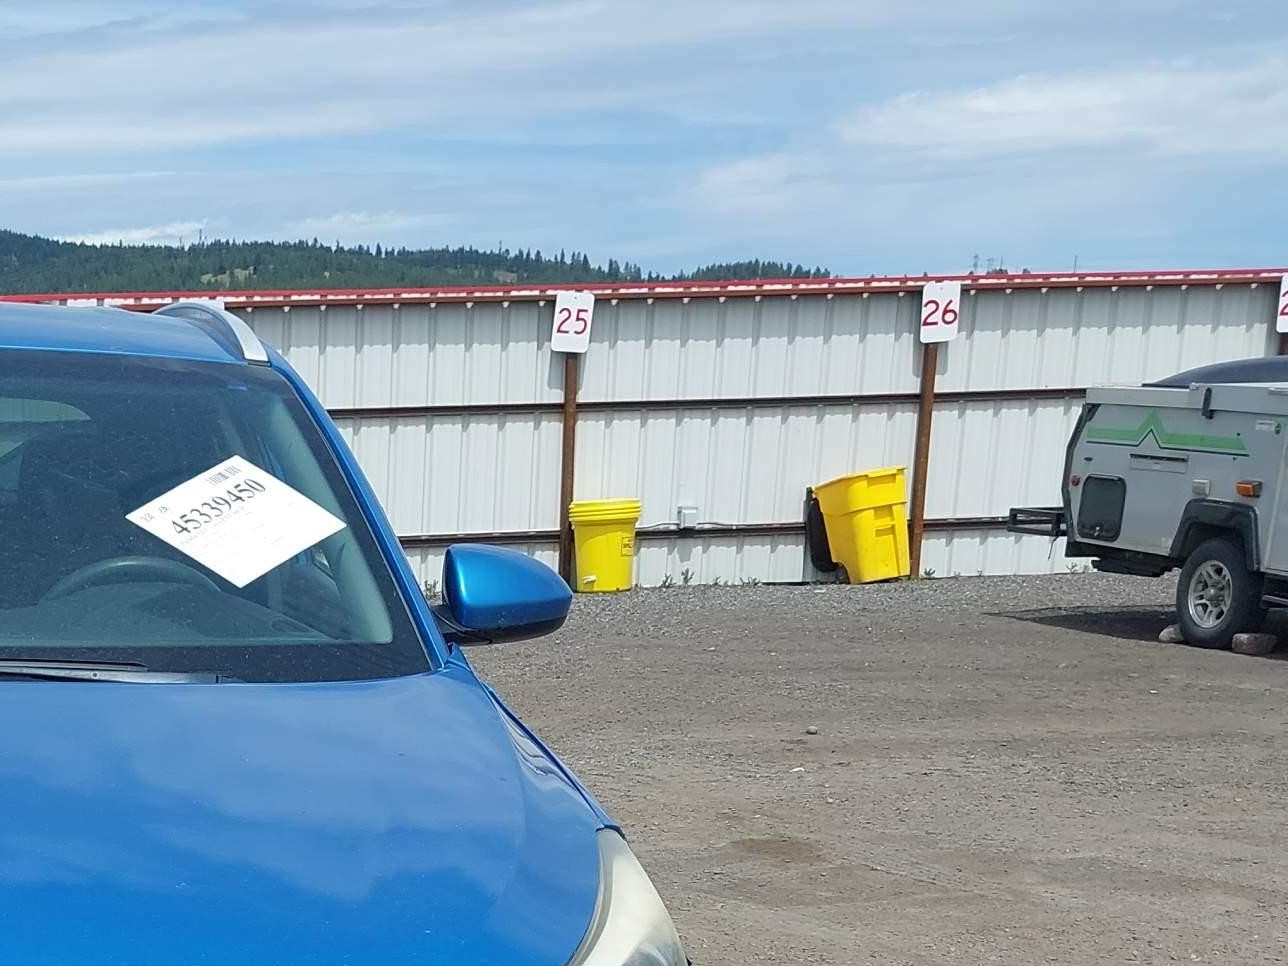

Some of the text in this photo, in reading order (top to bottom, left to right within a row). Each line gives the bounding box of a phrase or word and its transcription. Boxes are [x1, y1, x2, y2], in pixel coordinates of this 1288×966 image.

[921, 299, 958, 327] 26
[1279, 289, 1288, 317] 2
[556, 307, 589, 335] 25
[171, 479, 266, 534] 45339450
